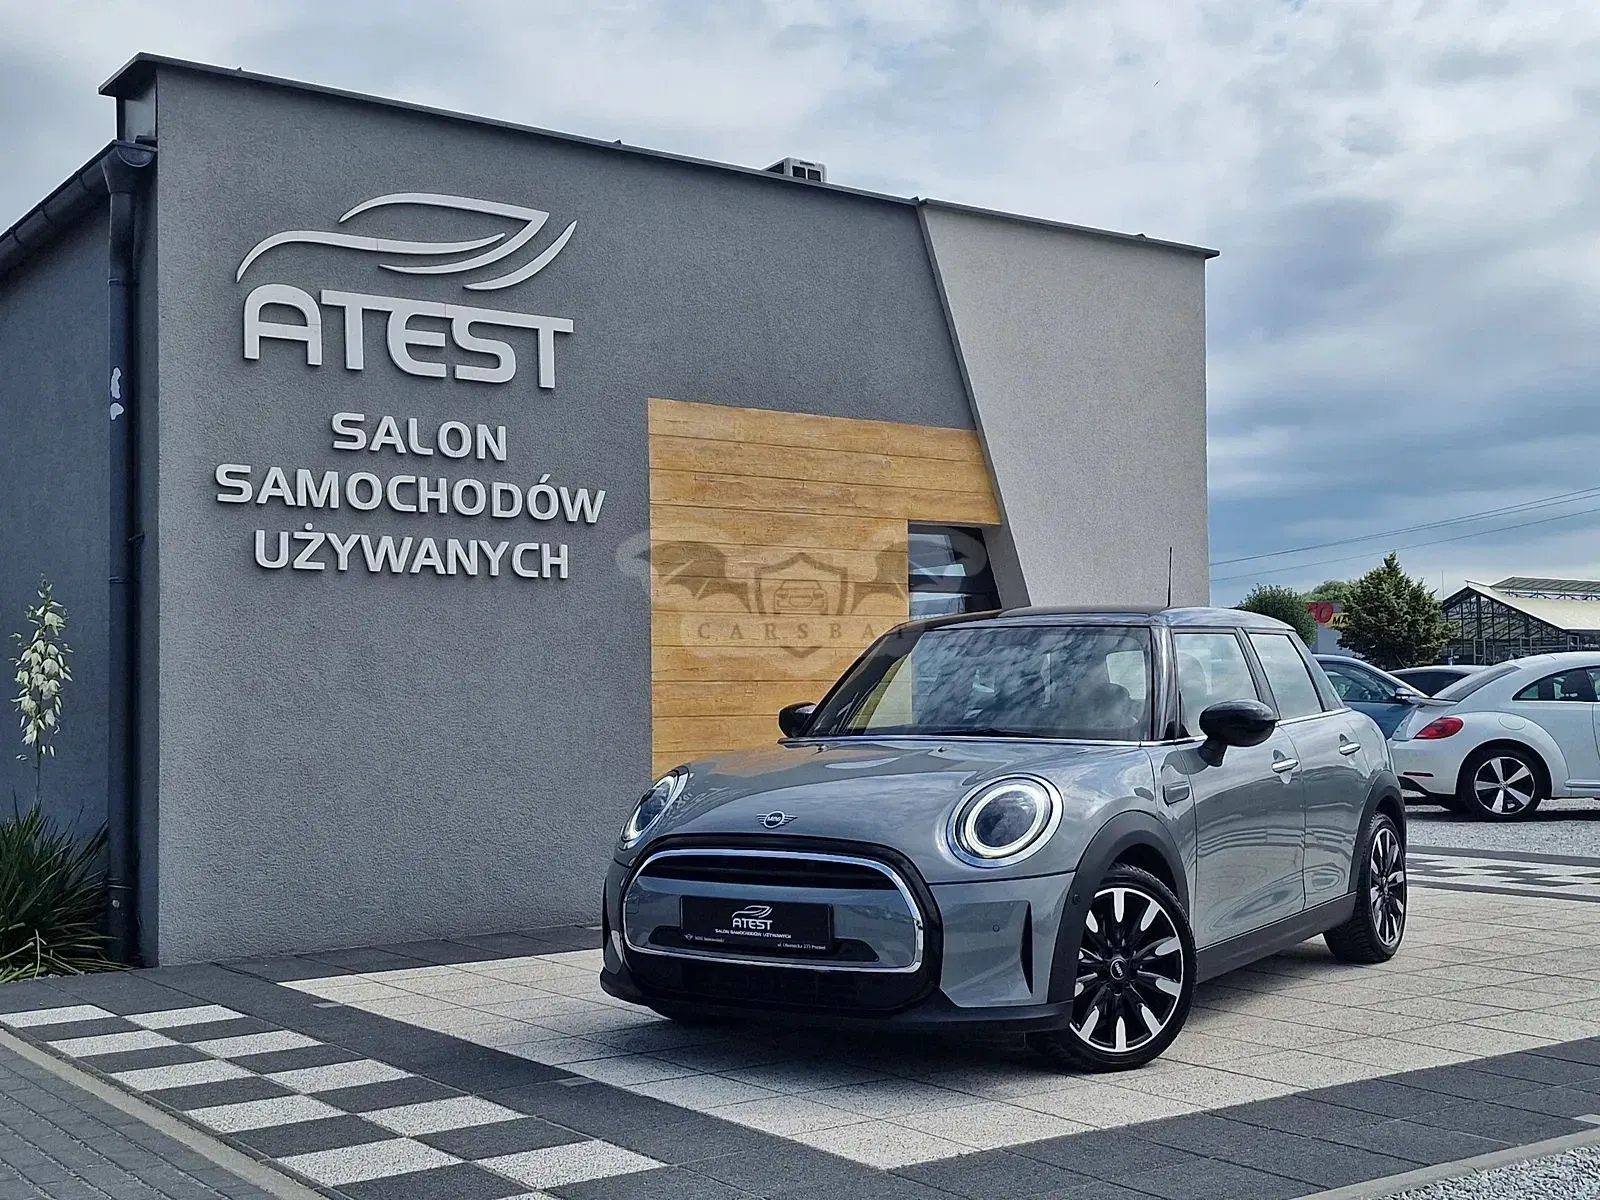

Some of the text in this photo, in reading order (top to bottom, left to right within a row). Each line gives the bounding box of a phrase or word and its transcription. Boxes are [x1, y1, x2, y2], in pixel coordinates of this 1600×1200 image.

[243, 283, 574, 389] ATEST
[331, 411, 507, 462] SALON
[214, 463, 607, 524] SAMOCHODÓW
[253, 522, 570, 580] UŻYWANYCH
[732, 917, 773, 931] ATEST
